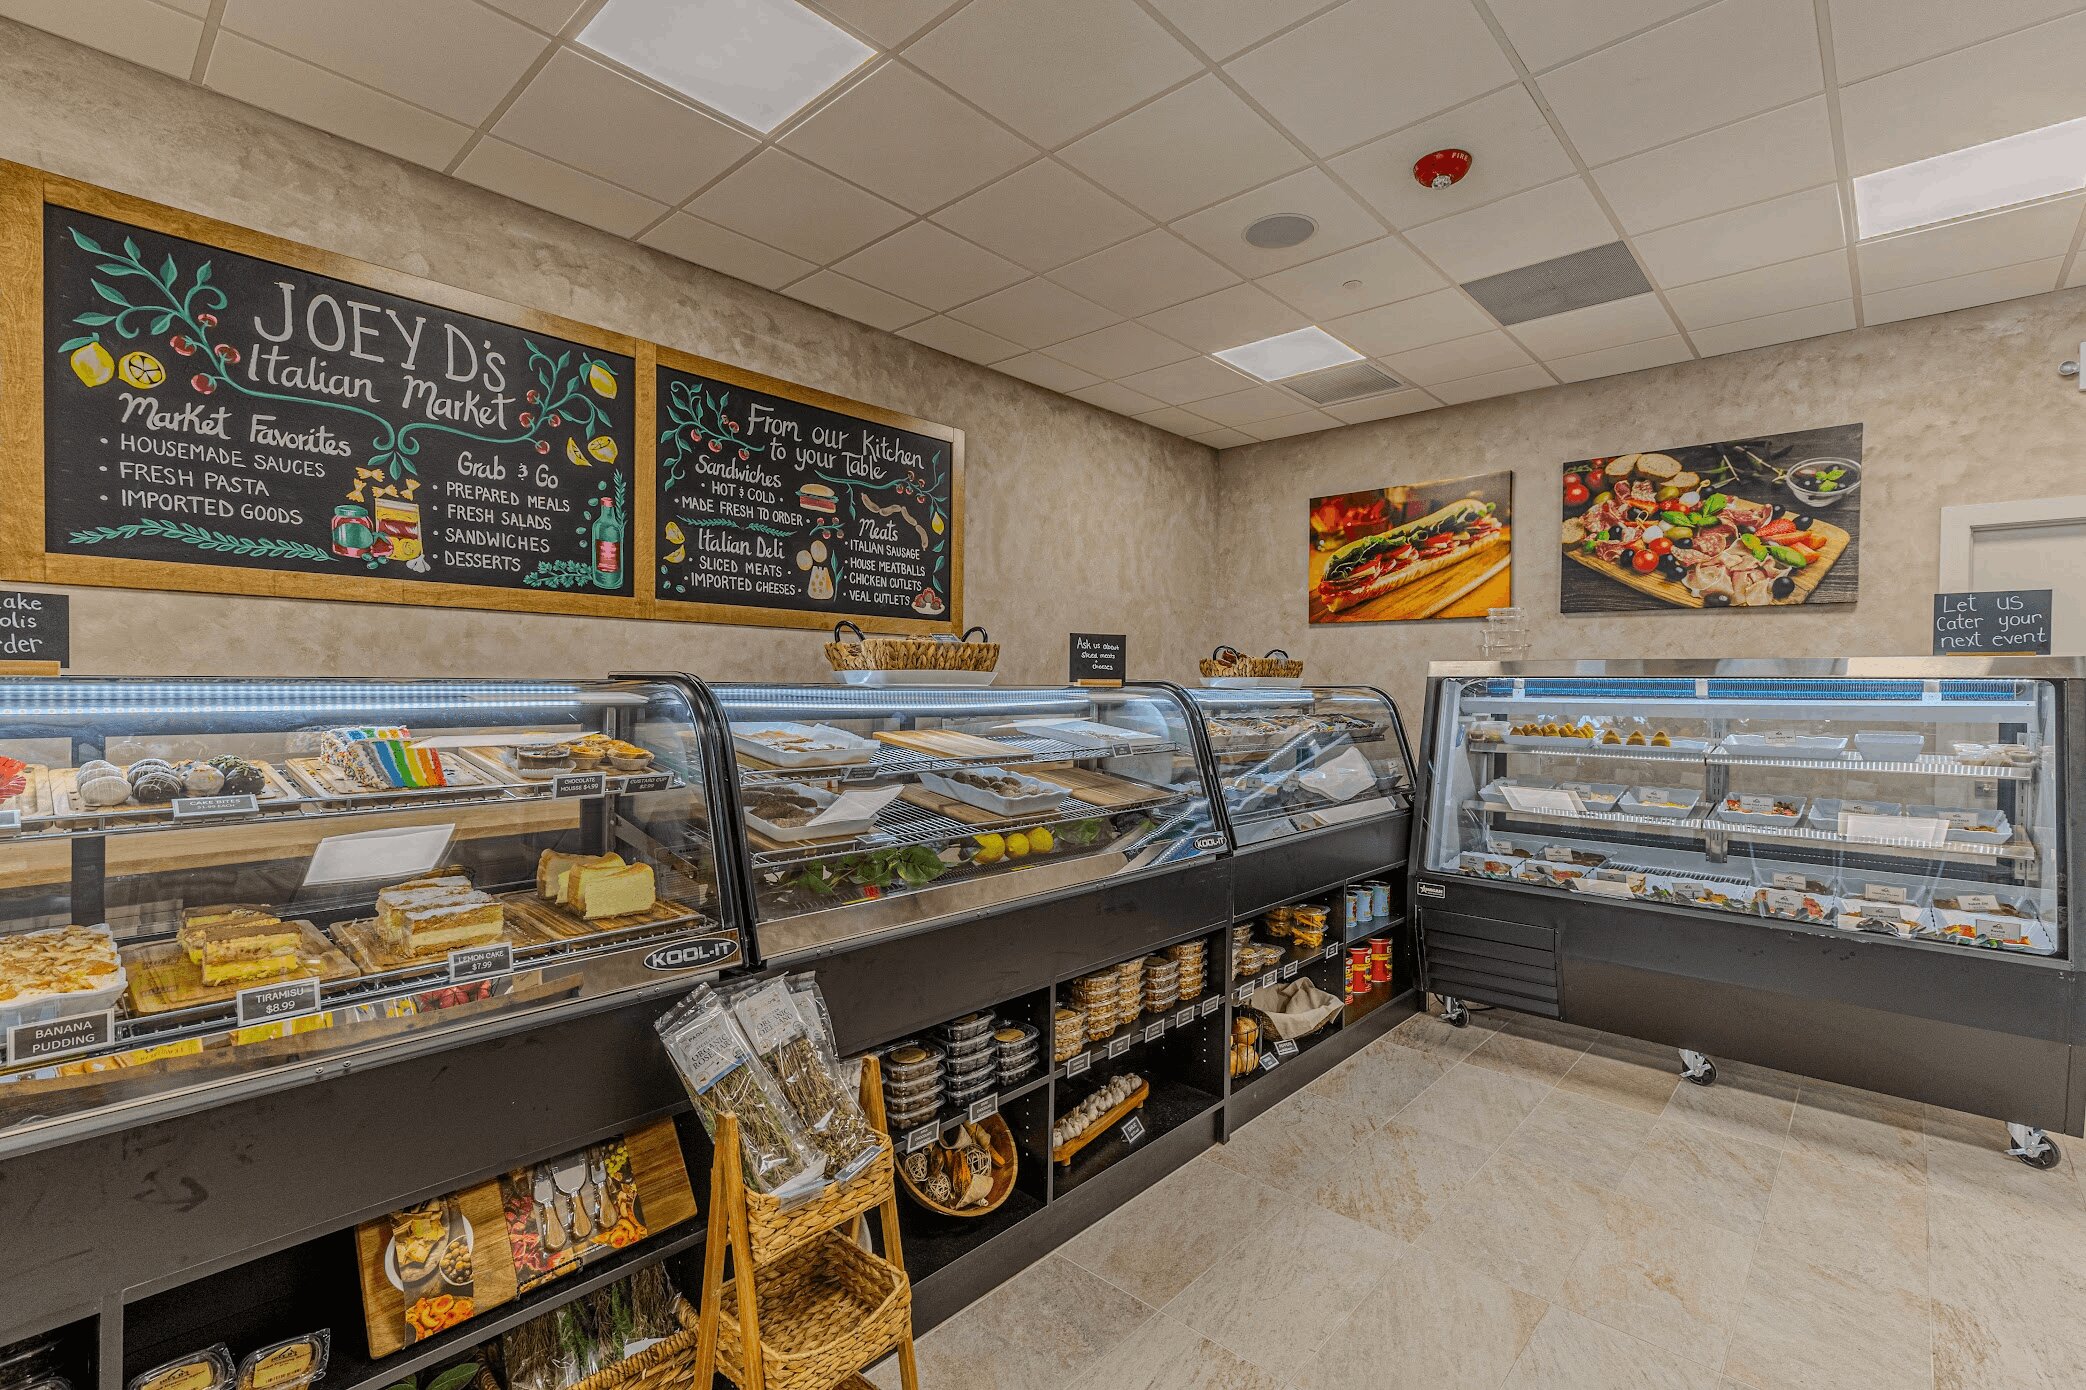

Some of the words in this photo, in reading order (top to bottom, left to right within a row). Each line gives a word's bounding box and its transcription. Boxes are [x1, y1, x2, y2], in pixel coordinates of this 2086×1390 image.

[1451, 152, 1468, 161] FIRE
[254, 281, 426, 371] JOEY
[247, 343, 381, 403] Italian
[401, 374, 516, 431] Market
[118, 392, 232, 441] Market
[249, 414, 352, 457] Favorites
[747, 402, 802, 442] From
[811, 426, 849, 450] our
[863, 429, 925, 470] Kitchen
[120, 433, 246, 468] HOUSEMADE
[253, 454, 326, 478] SAUCES
[770, 437, 786, 461] to
[794, 446, 837, 472] your
[841, 451, 888, 480] Table
[119, 461, 194, 488] FRESH
[204, 472, 270, 497] PASTA
[457, 450, 506, 481] Grab
[535, 464, 559, 489] Go
[695, 453, 782, 488] Sandwiches
[446, 481, 520, 507] PREPARED
[527, 495, 570, 513] MEALS
[711, 481, 737, 498] HOT
[747, 488, 776, 504] COLD
[121, 489, 234, 518] IMPORTED
[240, 503, 303, 525] GOODS
[447, 503, 494, 524] FRESH
[500, 511, 552, 531] SALADS
[681, 496, 714, 514] MADE
[719, 502, 754, 519] FRESH
[757, 507, 770, 521] TO
[772, 510, 803, 527] ORDER
[445, 527, 550, 553] SANDWICHES
[858, 517, 899, 543] Meats
[698, 527, 752, 556] Italian
[756, 536, 786, 560] Deli
[850, 538, 884, 556] ITALIAN
[886, 545, 920, 561] SAUSAGE
[444, 550, 521, 572] DESSERTS
[699, 555, 738, 573] SLICED
[745, 562, 782, 578] MEATS
[850, 557, 876, 573] HOUSE
[878, 560, 926, 577] MEATBALLS
[690, 571, 752, 592] IMPORTED
[755, 579, 796, 596] CHEESES
[849, 572, 888, 588] CHICKEN
[890, 576, 922, 592] CUTLETS
[0, 592, 42, 611] ake
[849, 589, 872, 603] VEAL
[873, 592, 910, 606] CUTLETS
[1943, 594, 1978, 613] Let
[1996, 595, 2024, 610] us
[1999, 613, 2043, 633] your
[0, 633, 43, 654] der
[1076, 636, 1092, 650] Ask
[1102, 643, 1120, 651] about
[1940, 631, 1983, 648] next
[1992, 626, 2048, 647] event
[563, 776, 596, 785] CHOCOLATE
[458, 953, 485, 964] LEMON
[485, 950, 505, 959] CAKE
[471, 960, 492, 971] $7.99
[255, 987, 304, 1004] TIRAMISU
[265, 1000, 296, 1014] $8.99
[35, 1020, 93, 1039] BANANA
[756, 1007, 790, 1030] ORGANIC
[32, 1033, 95, 1053] PUDDING
[691, 1033, 727, 1061] ORGANIC
